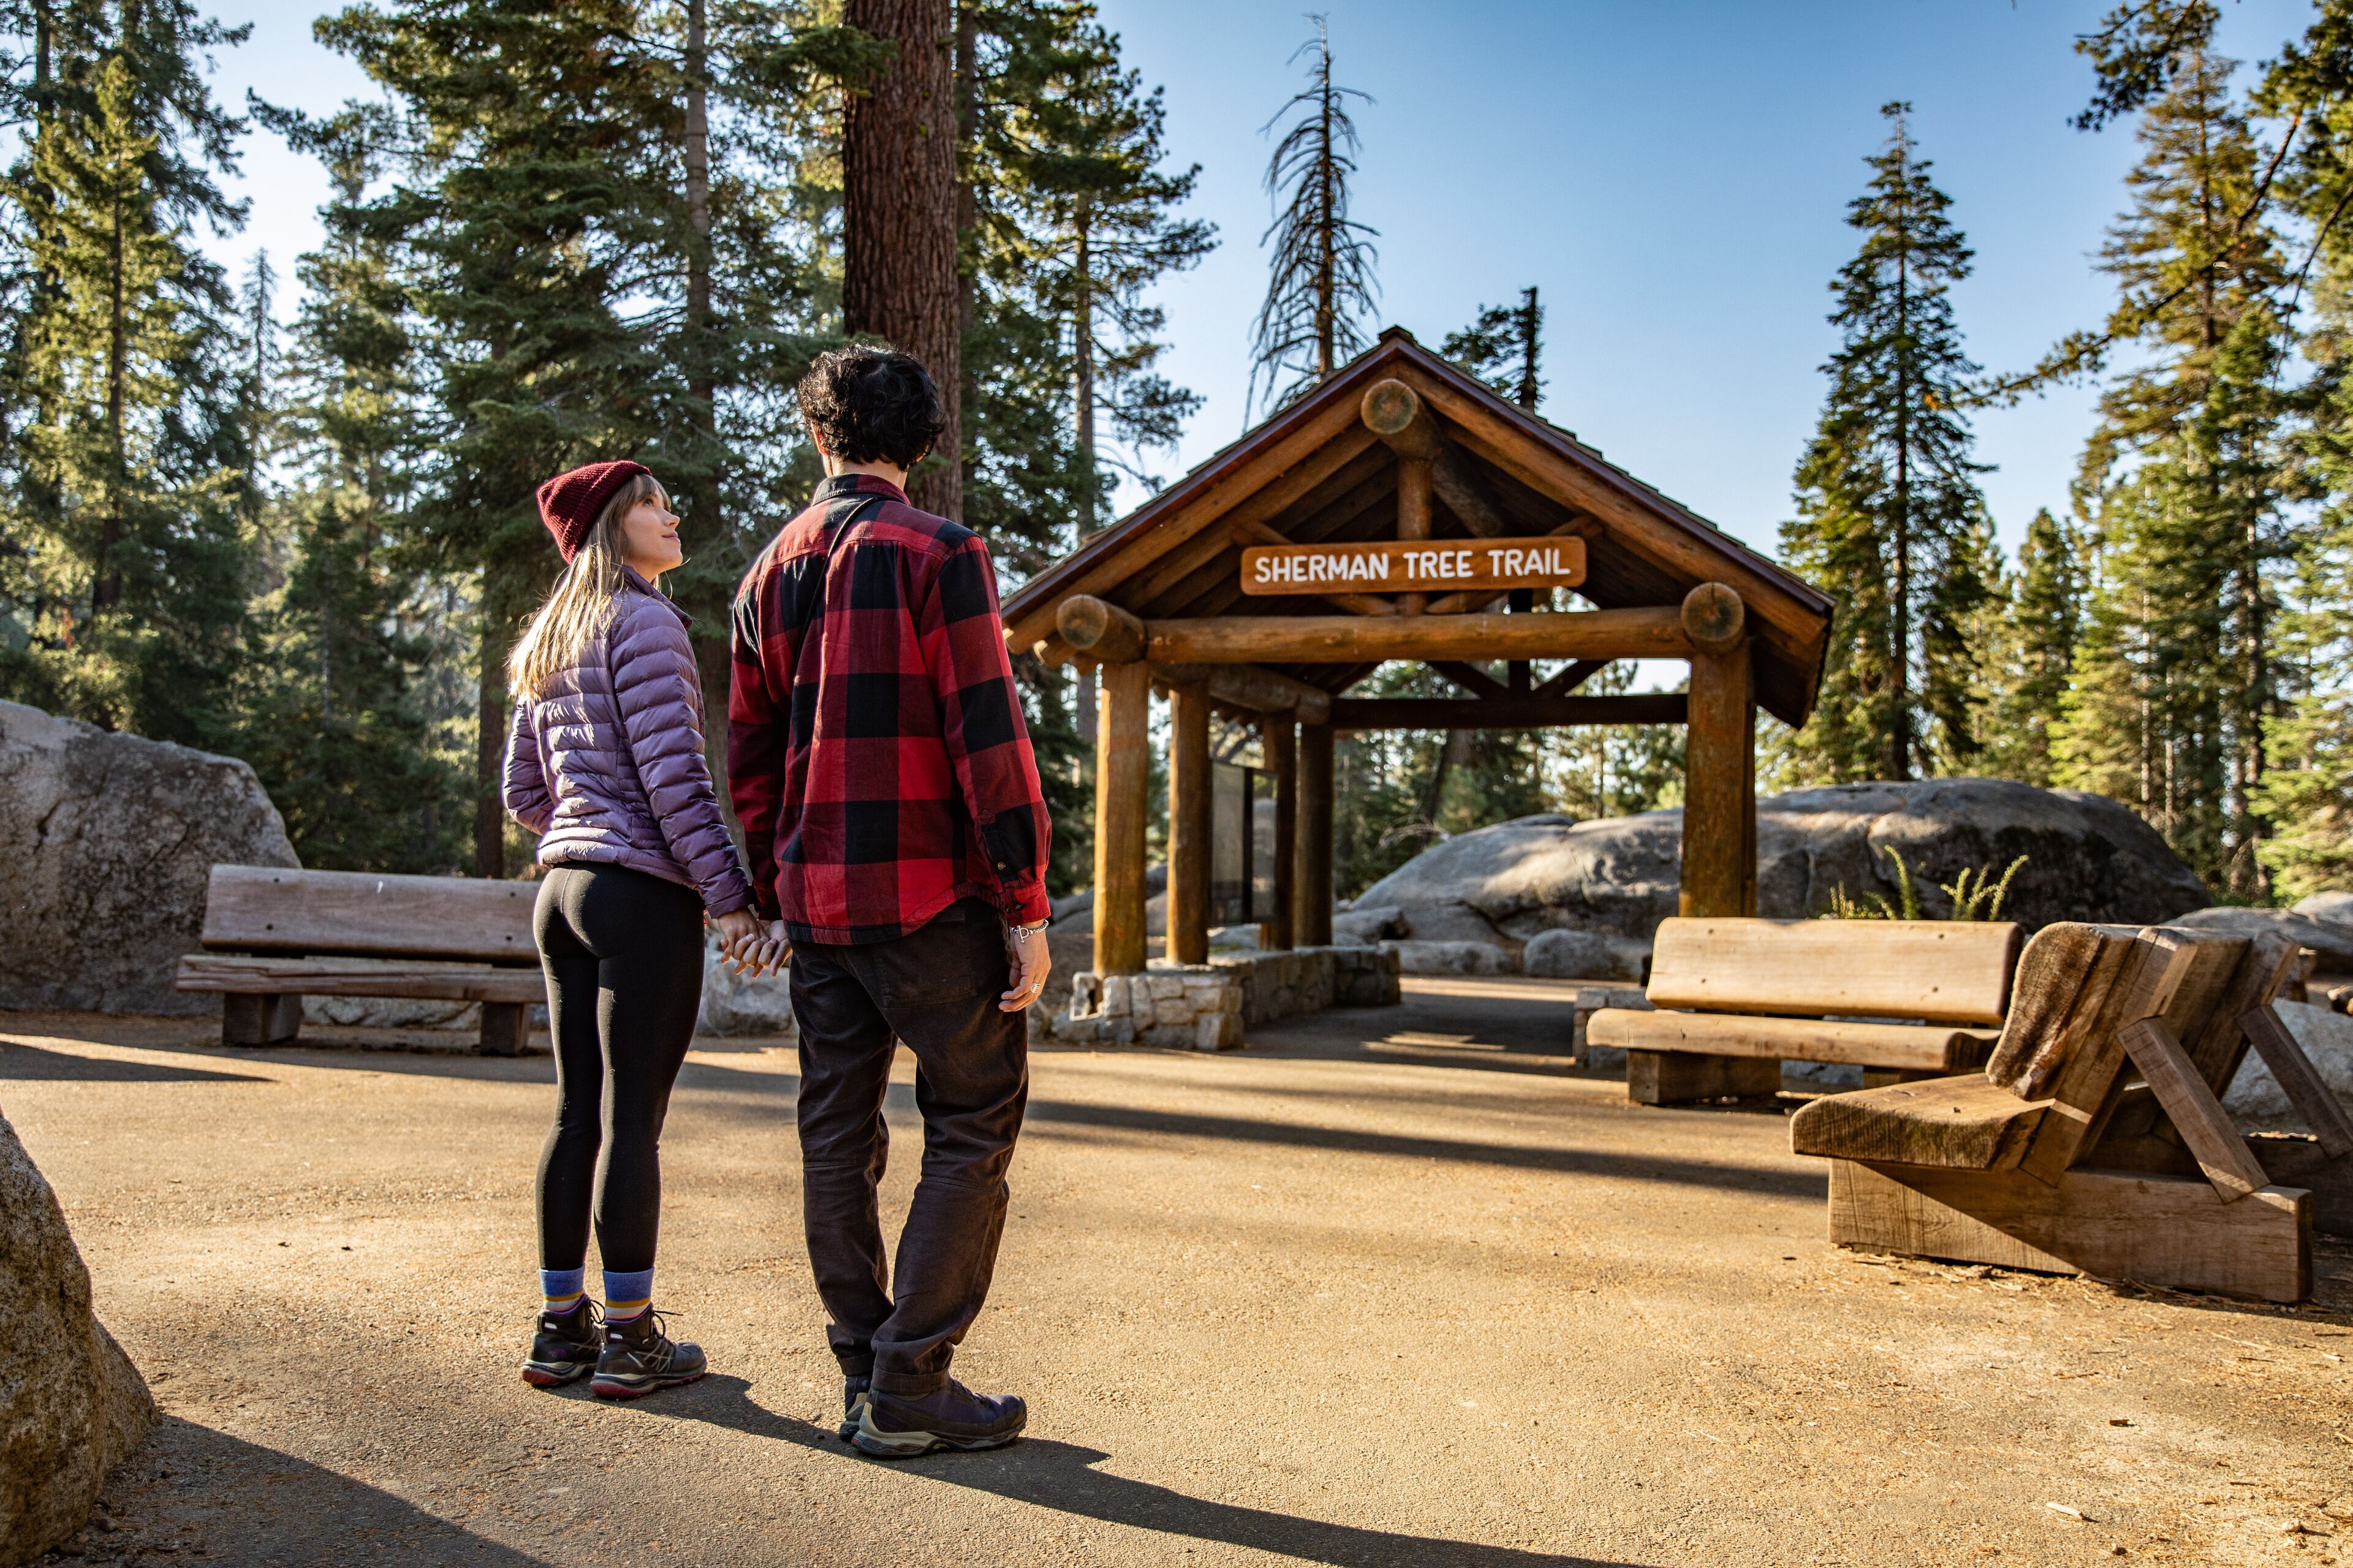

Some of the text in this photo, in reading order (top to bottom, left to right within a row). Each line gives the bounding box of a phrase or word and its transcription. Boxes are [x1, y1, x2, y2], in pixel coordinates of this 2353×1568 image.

[1255, 548, 1571, 583] SHERMAN TREE TRAIL
